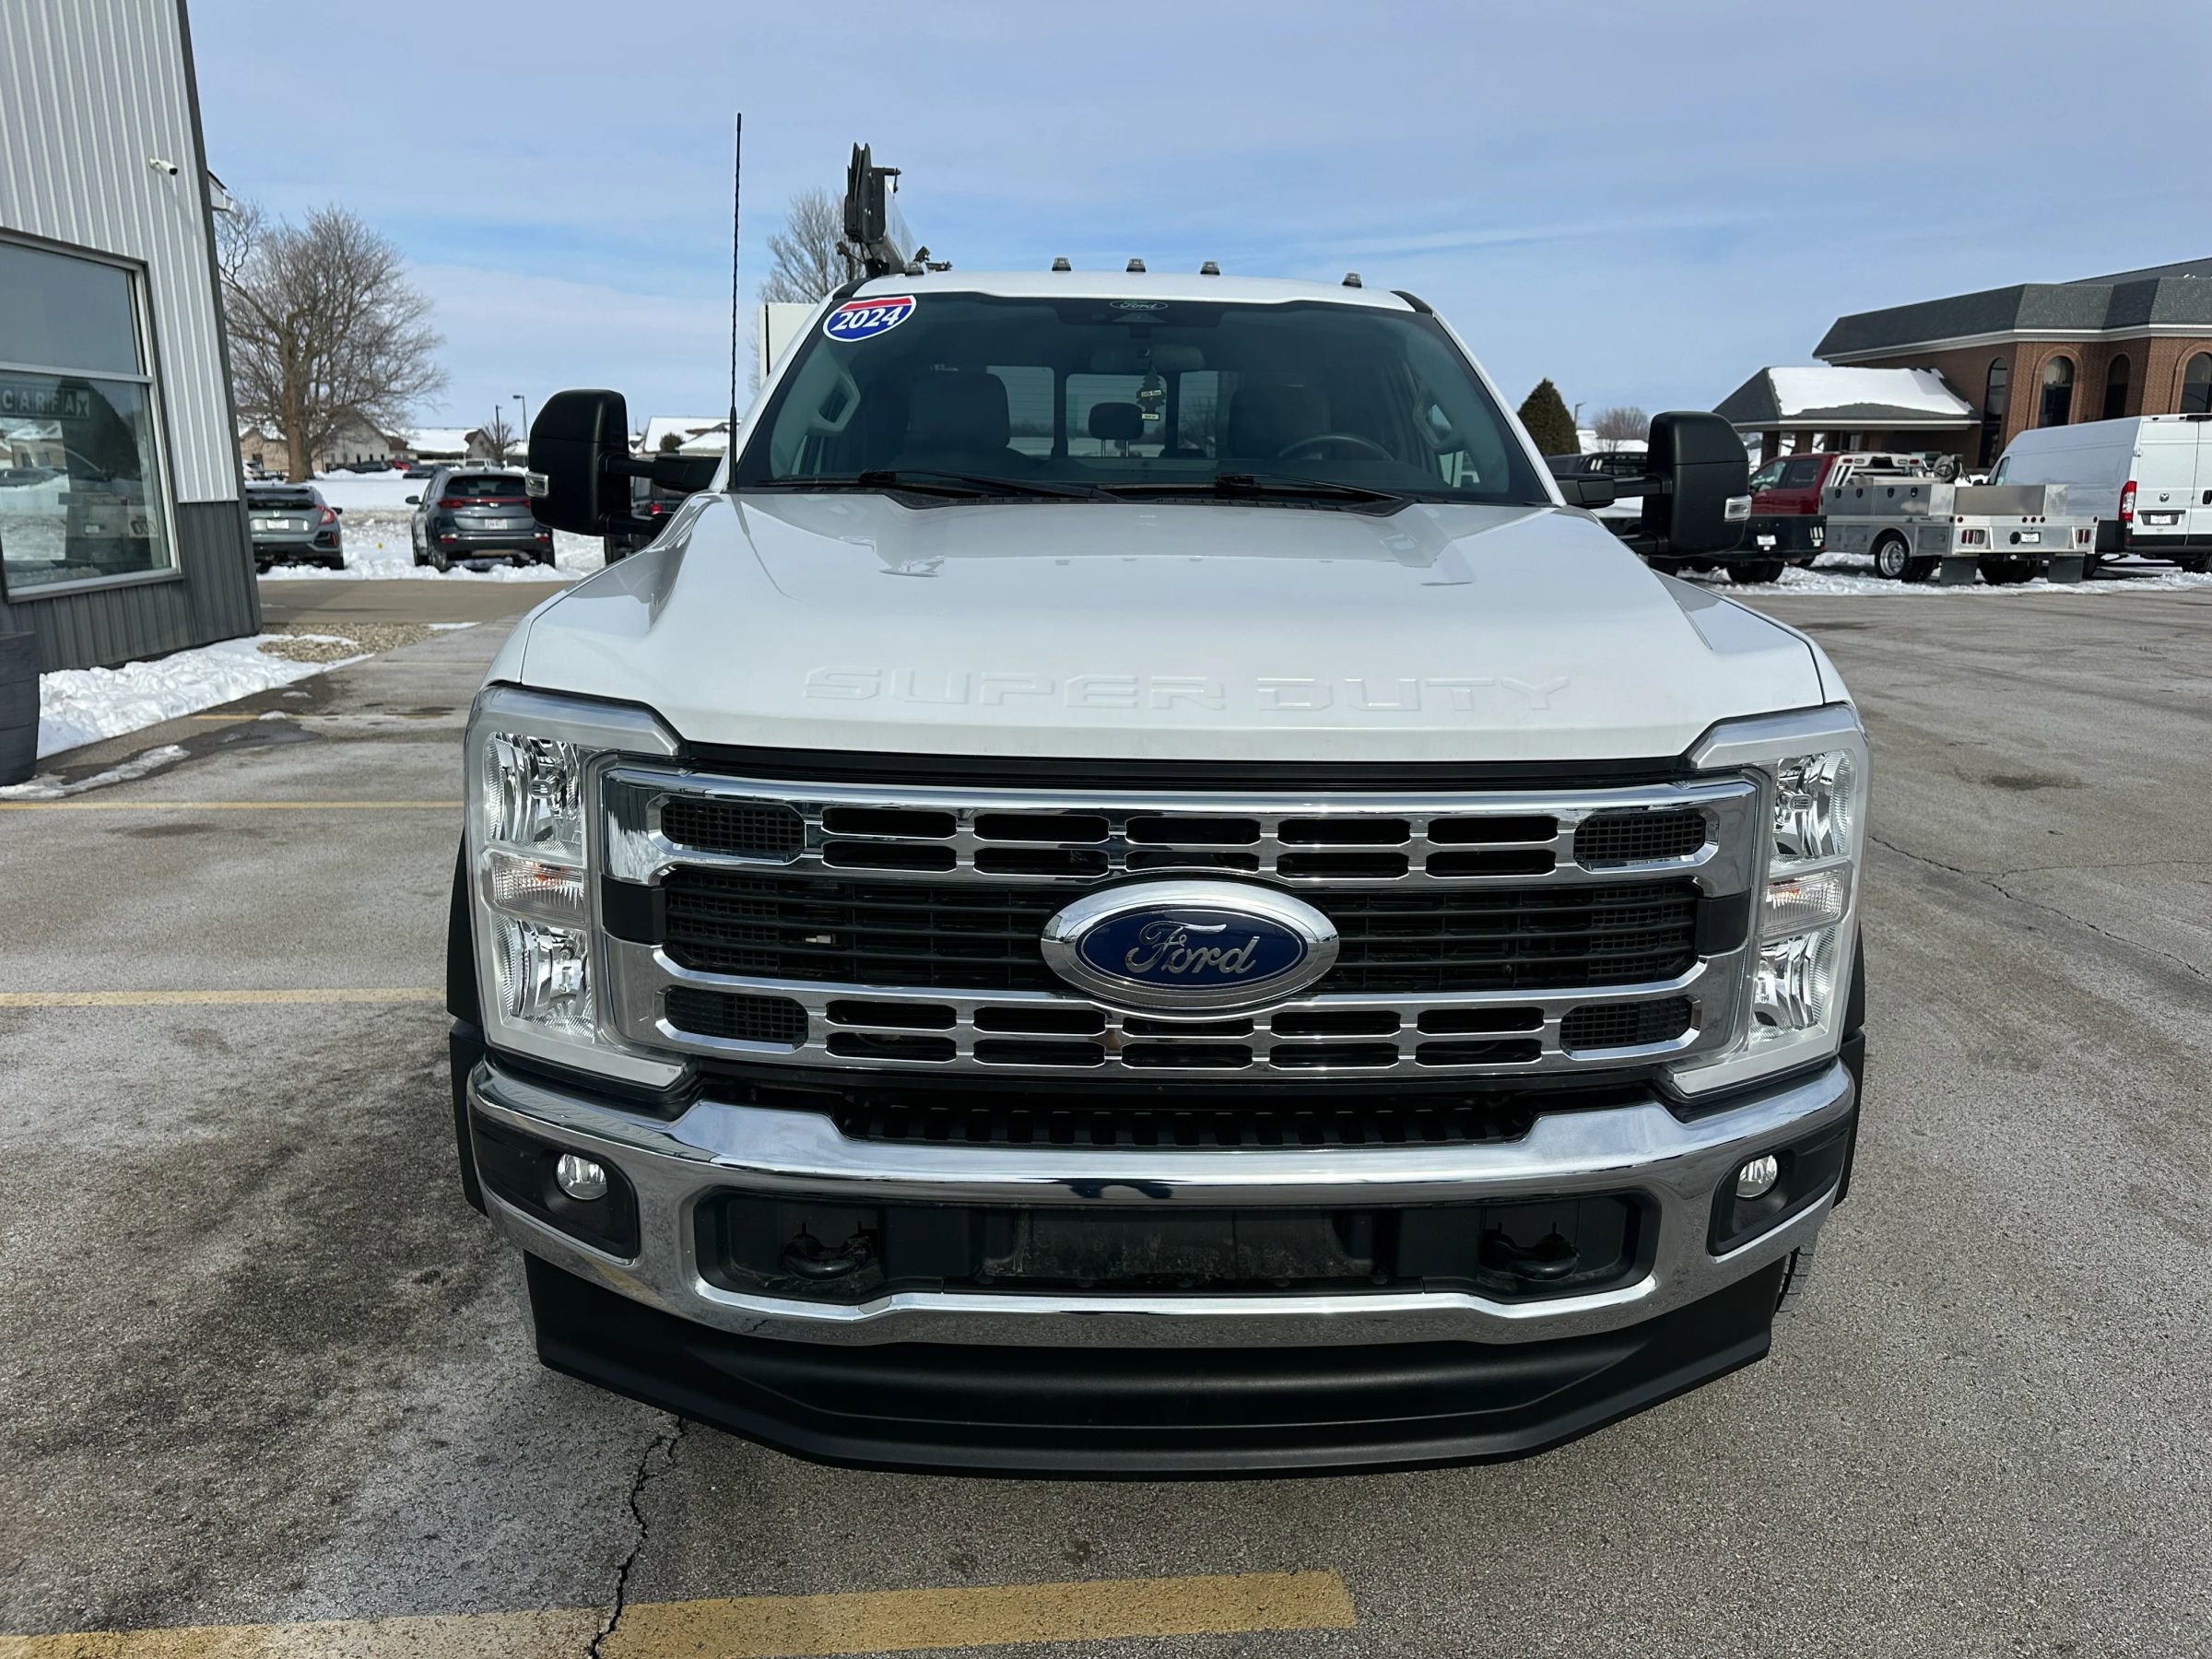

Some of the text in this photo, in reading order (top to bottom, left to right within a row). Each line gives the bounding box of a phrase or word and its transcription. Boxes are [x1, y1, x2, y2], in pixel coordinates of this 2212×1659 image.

[830, 306, 903, 332] 2024
[2, 389, 88, 418] CARFAX
[804, 665, 1570, 711] SUPER DUTY
[1124, 921, 1261, 974] Ford
